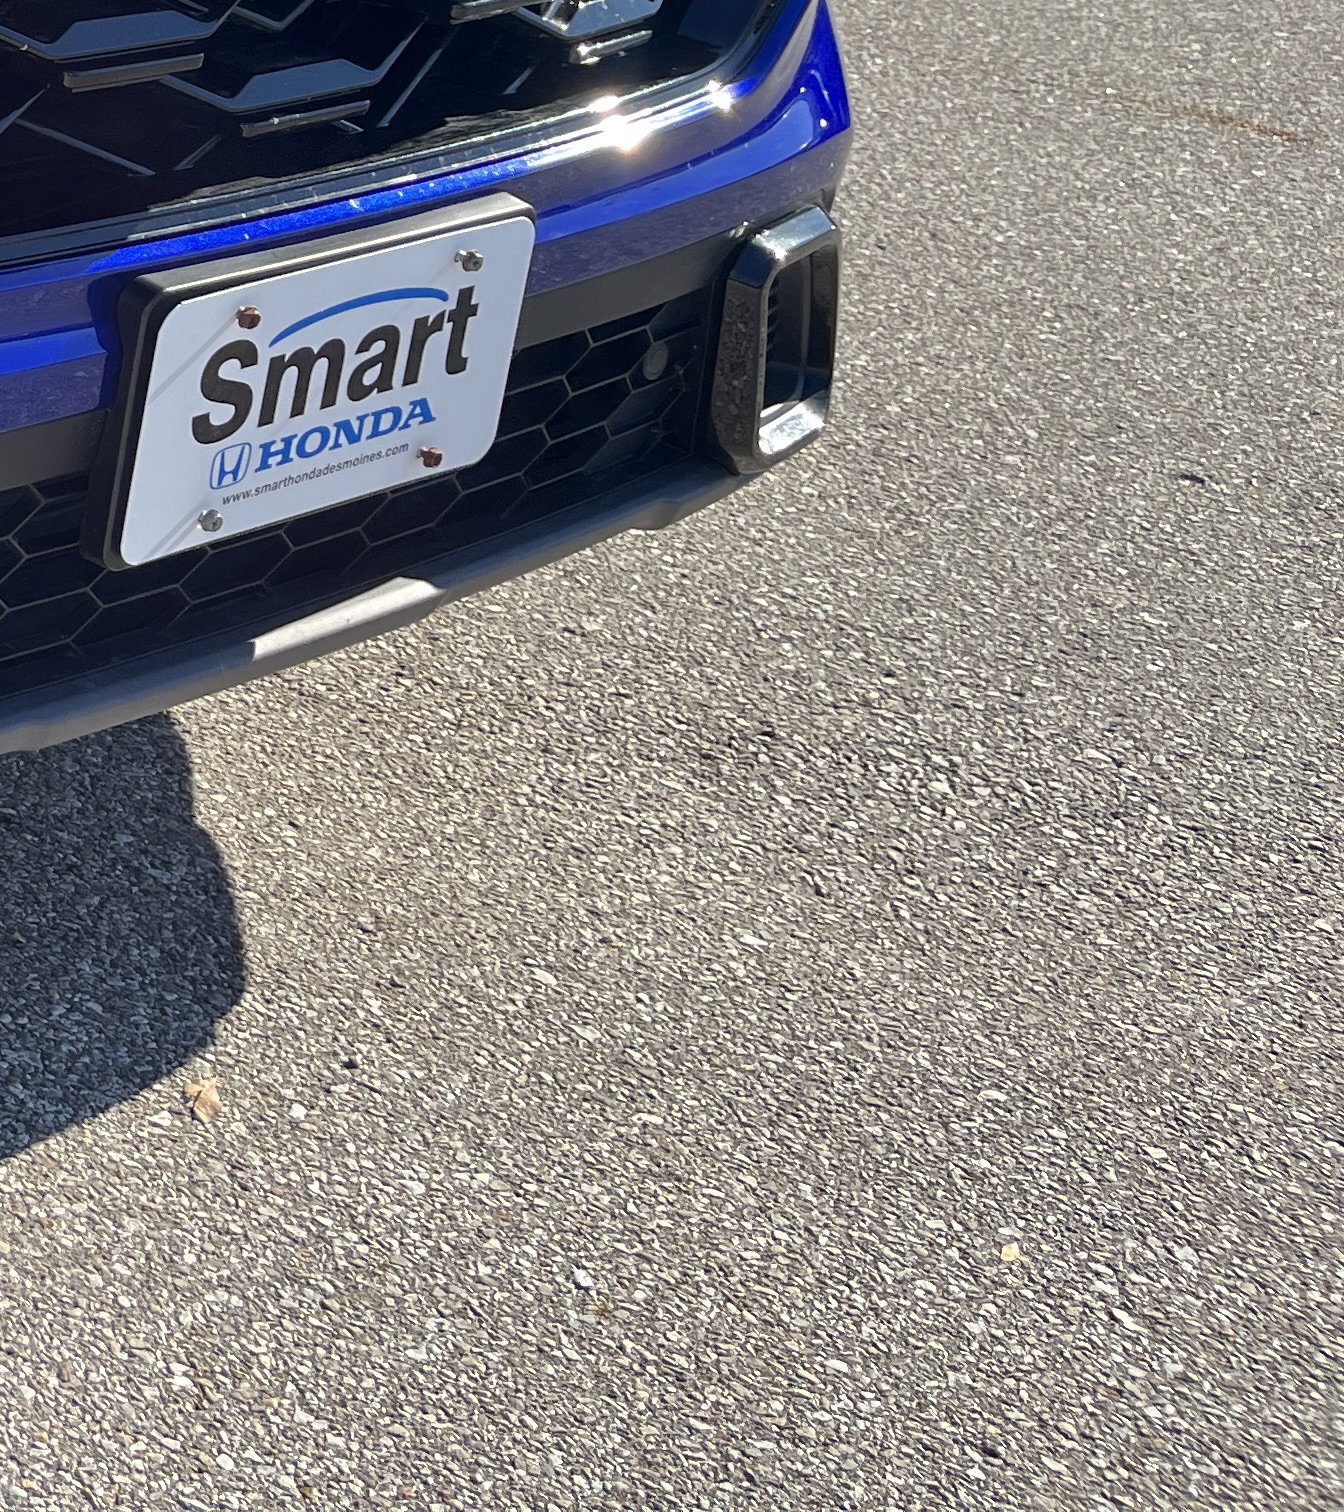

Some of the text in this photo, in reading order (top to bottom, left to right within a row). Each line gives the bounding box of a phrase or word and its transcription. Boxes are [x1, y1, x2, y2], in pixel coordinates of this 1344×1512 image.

[191, 285, 480, 445] Smart
[254, 396, 437, 473] HONDA
[221, 441, 410, 506] www.smarthondadesmoines.com
